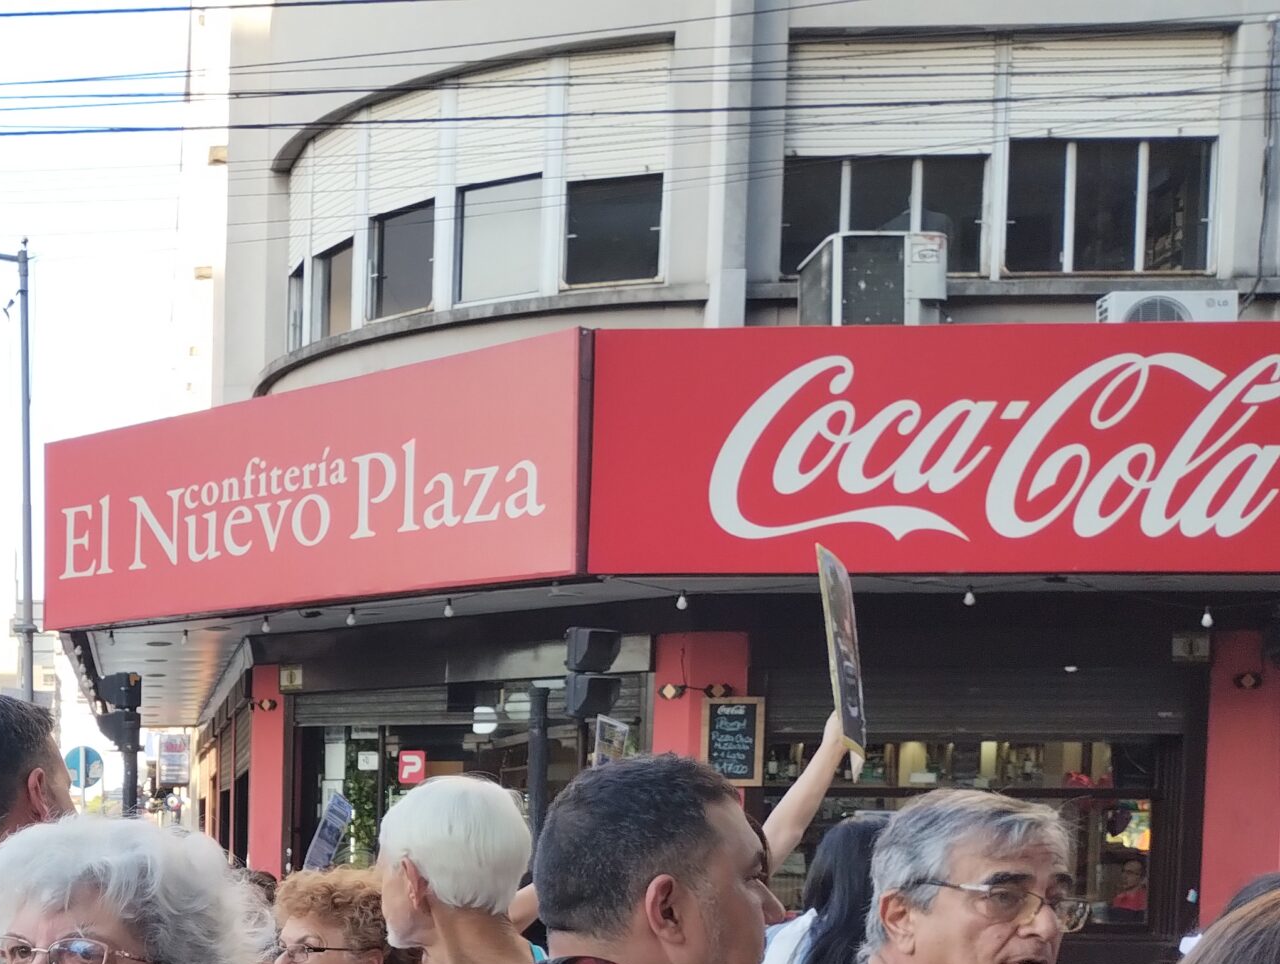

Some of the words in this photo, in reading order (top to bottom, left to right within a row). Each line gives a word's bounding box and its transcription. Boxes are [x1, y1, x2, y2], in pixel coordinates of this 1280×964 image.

[58, 494, 114, 580] El
[128, 486, 331, 571] Nuevo
[349, 438, 546, 540] Plaza
[183, 446, 347, 509] confitería
[708, 352, 1280, 540] Coca-Cola
